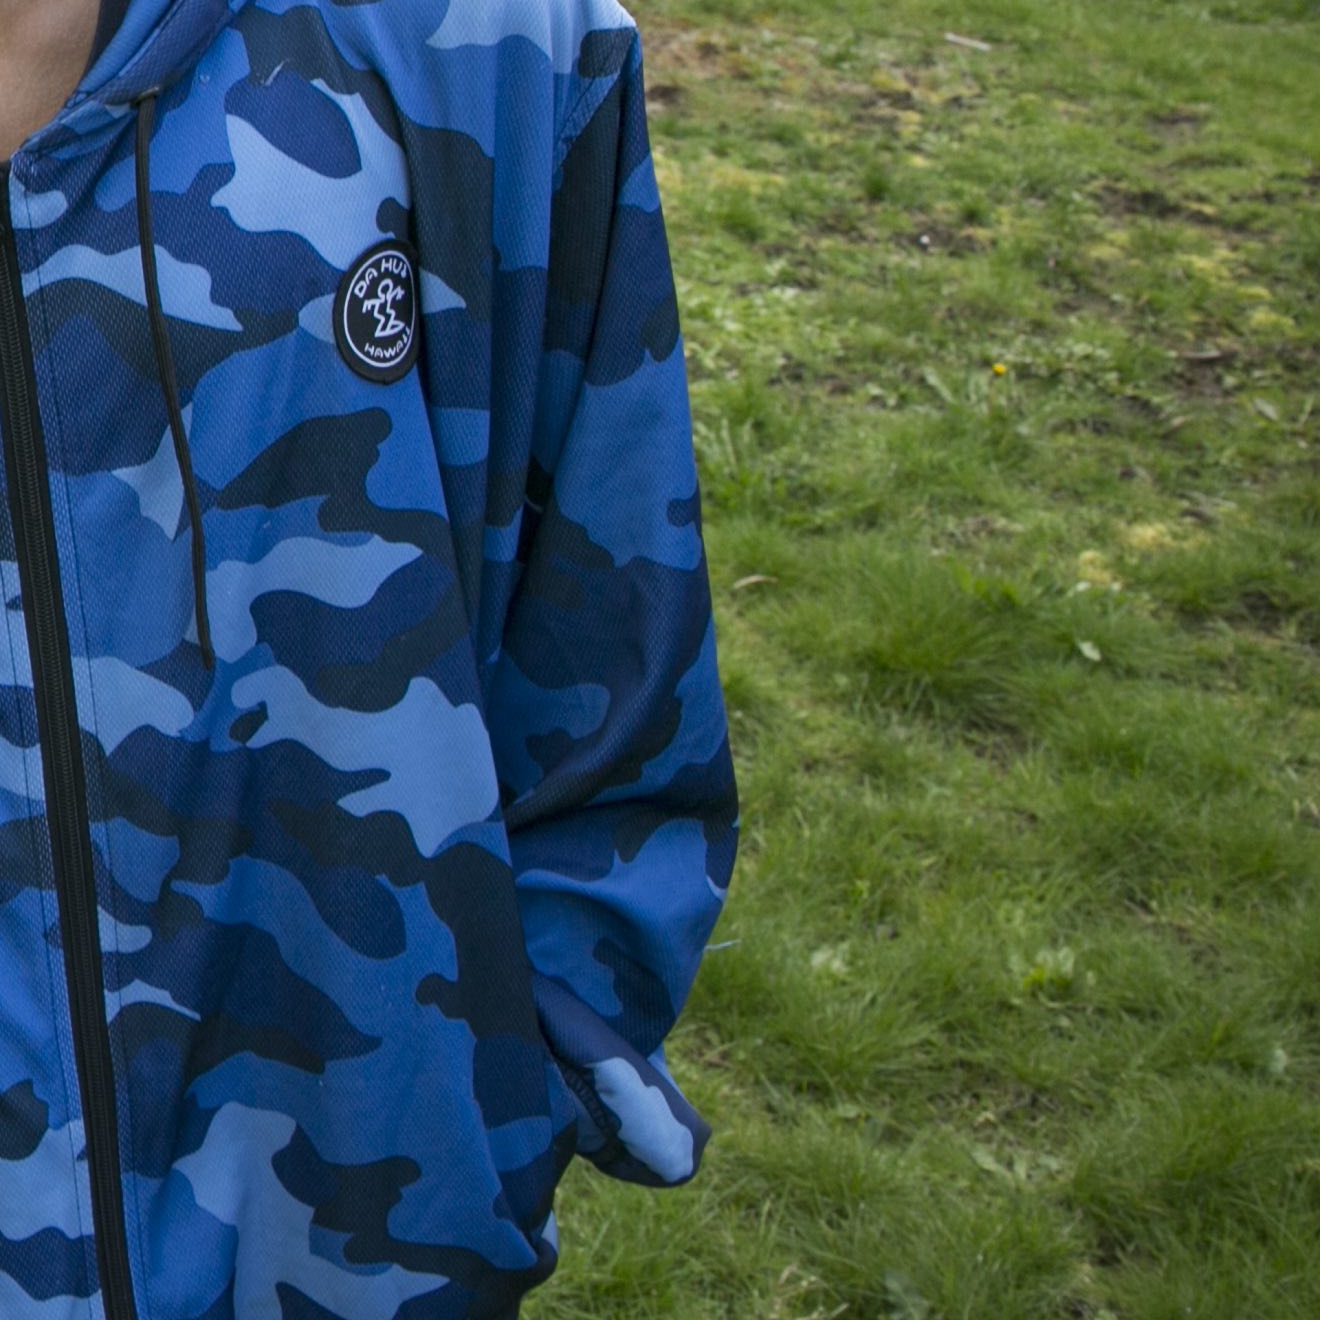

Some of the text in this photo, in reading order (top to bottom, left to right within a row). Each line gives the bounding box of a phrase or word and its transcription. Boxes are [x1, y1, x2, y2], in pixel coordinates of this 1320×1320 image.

[354, 257, 408, 299] DA HUI
[364, 327, 411, 358] HAWAII
